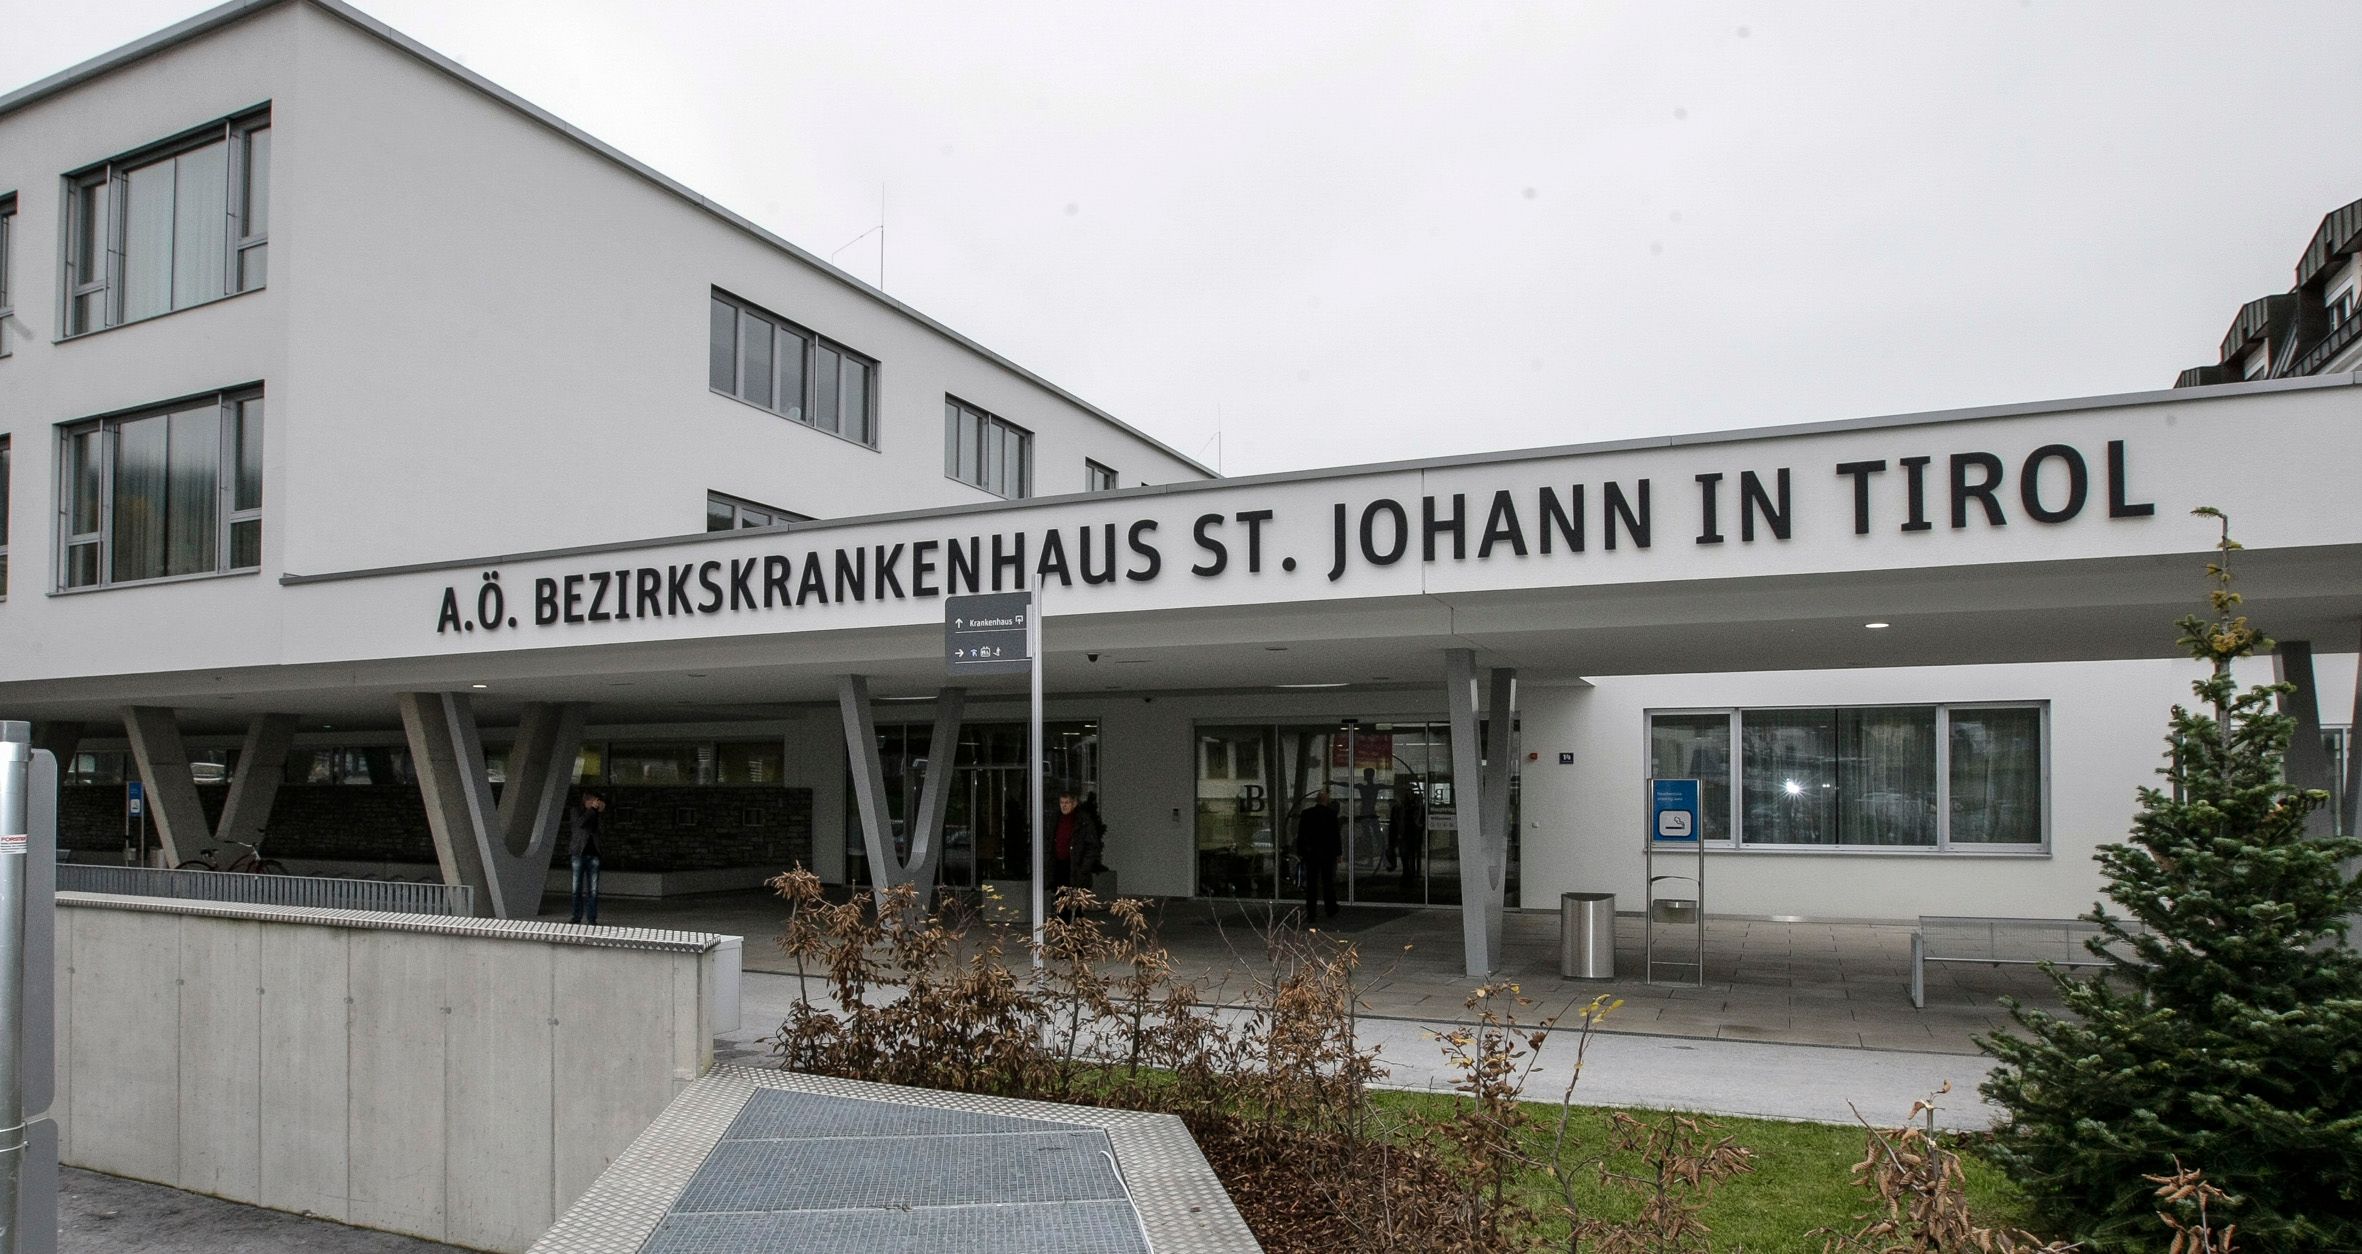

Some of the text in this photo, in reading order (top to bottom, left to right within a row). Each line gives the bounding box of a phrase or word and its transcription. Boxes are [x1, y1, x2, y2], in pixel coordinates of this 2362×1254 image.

[436, 440, 2155, 633] A.Ö. BEZIRKSKRANKENHAUS ST. JOHANN IN TIROL
[969, 618, 1013, 627] Krankenhaus
